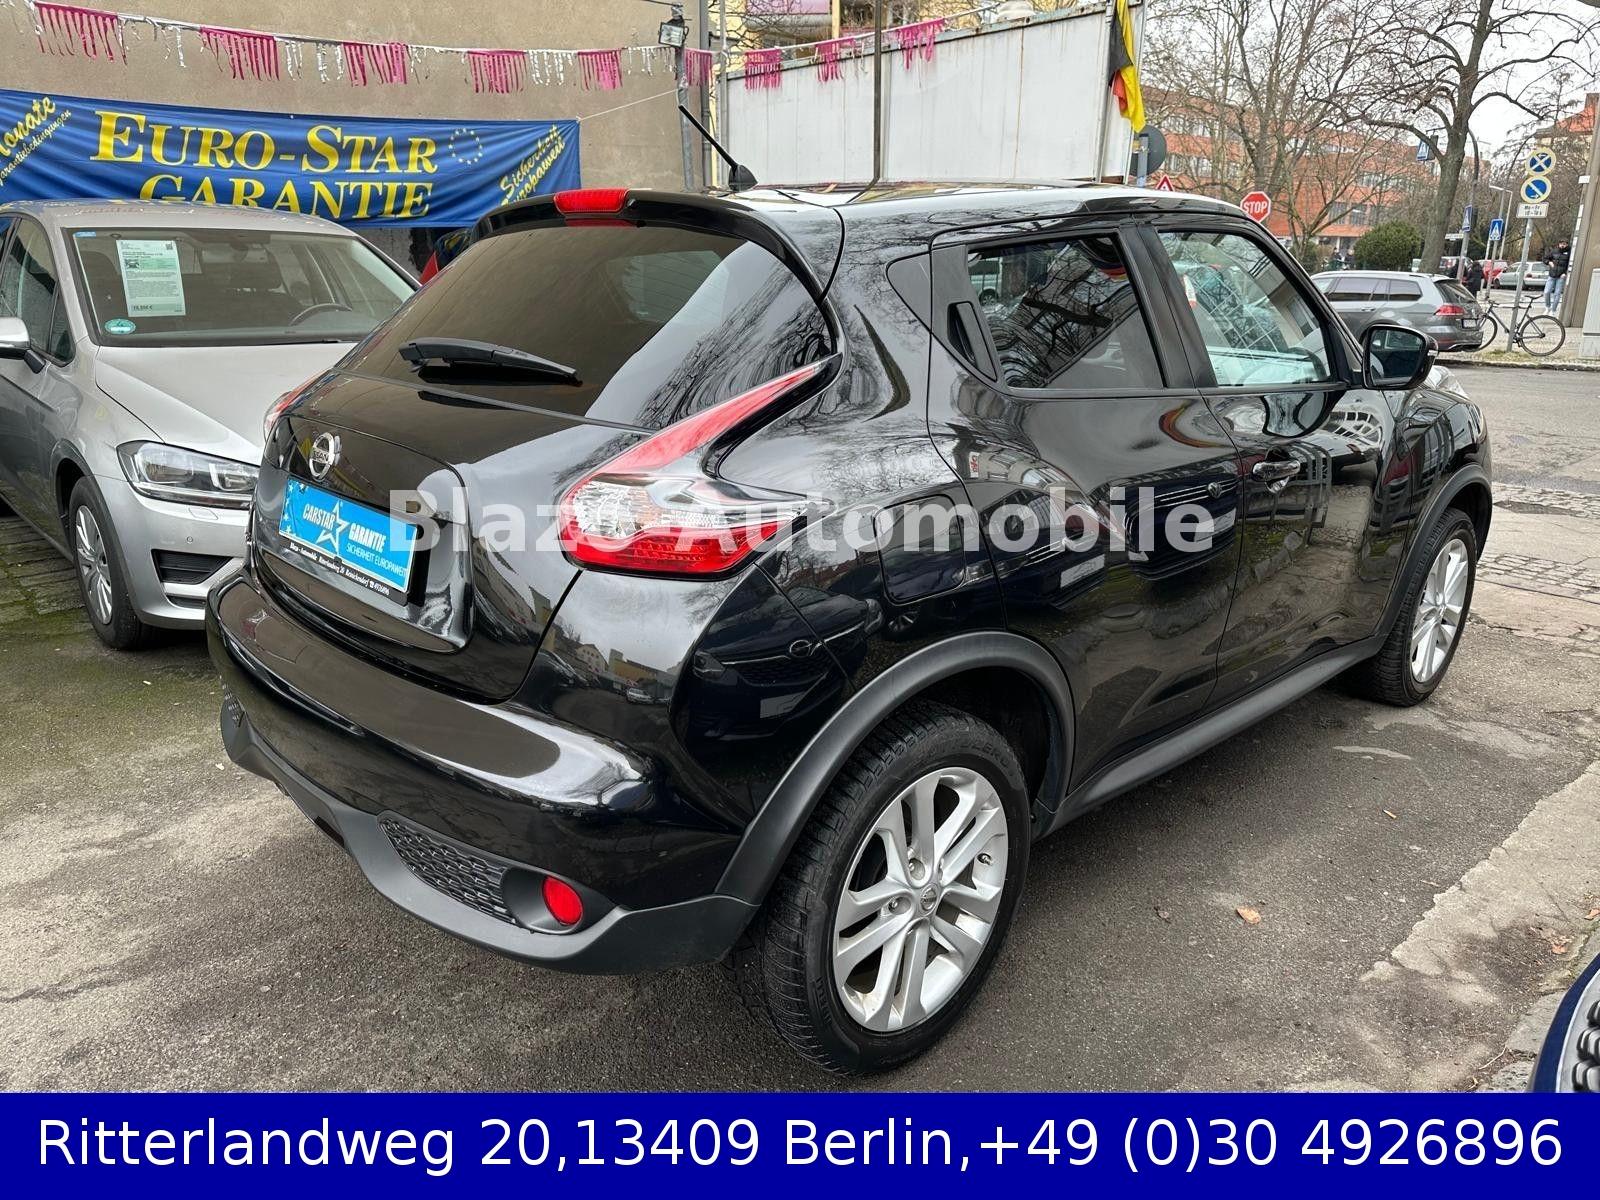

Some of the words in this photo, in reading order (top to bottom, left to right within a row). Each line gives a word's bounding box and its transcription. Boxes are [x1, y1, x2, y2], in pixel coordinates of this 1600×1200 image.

[90, 110, 438, 174] EURO-STAR
[139, 174, 434, 219] GARANTIE
[1243, 200, 1268, 214] STOP
[303, 503, 336, 530] CARSTAR
[348, 521, 387, 552] GARANTIE
[346, 542, 375, 563] SICHERHEIT
[374, 555, 407, 578] EUROPAWEIT
